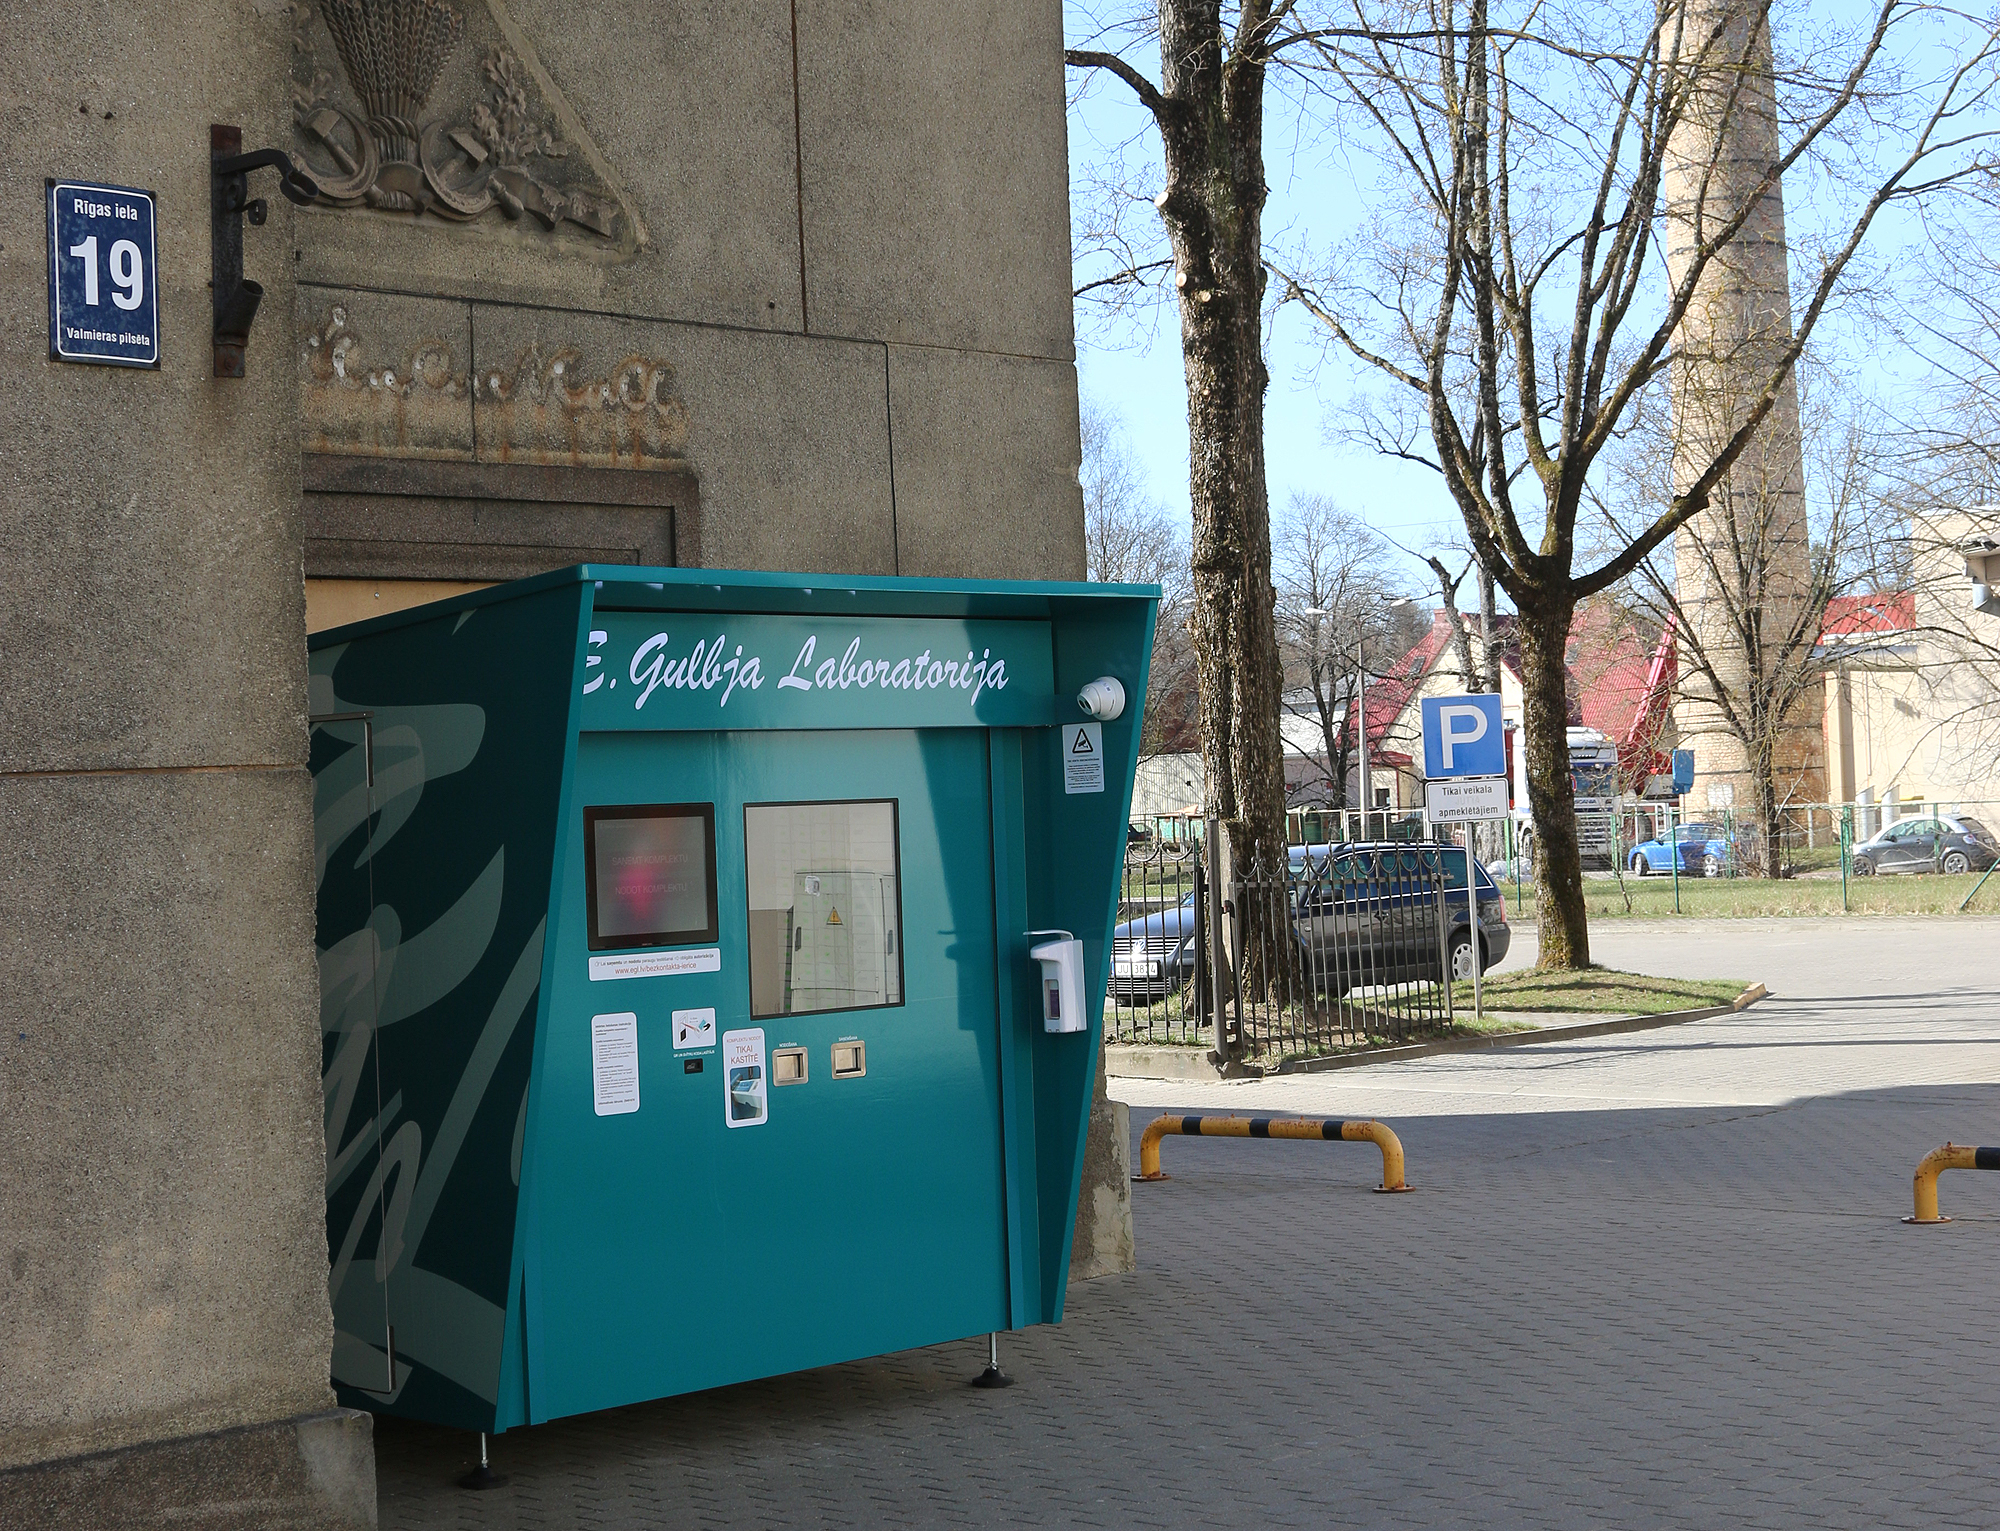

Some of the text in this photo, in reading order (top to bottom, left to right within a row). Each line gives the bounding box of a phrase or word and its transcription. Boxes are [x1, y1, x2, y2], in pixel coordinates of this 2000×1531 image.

[74, 198, 138, 221] Rīgas iela
[69, 235, 144, 311] 19
[66, 326, 150, 346] Valmieras pilsēta
[629, 631, 766, 710] Gulbja
[777, 634, 1009, 707] Laboratorija
[1440, 704, 1488, 769] P
[1442, 785, 1493, 796] Tikai veikala
[1439, 805, 1499, 818] apmeklētājiem
[1118, 964, 1156, 974] JU 384
[736, 1044, 753, 1053] TIKAI
[730, 1053, 759, 1064] KASTĪTĒ
